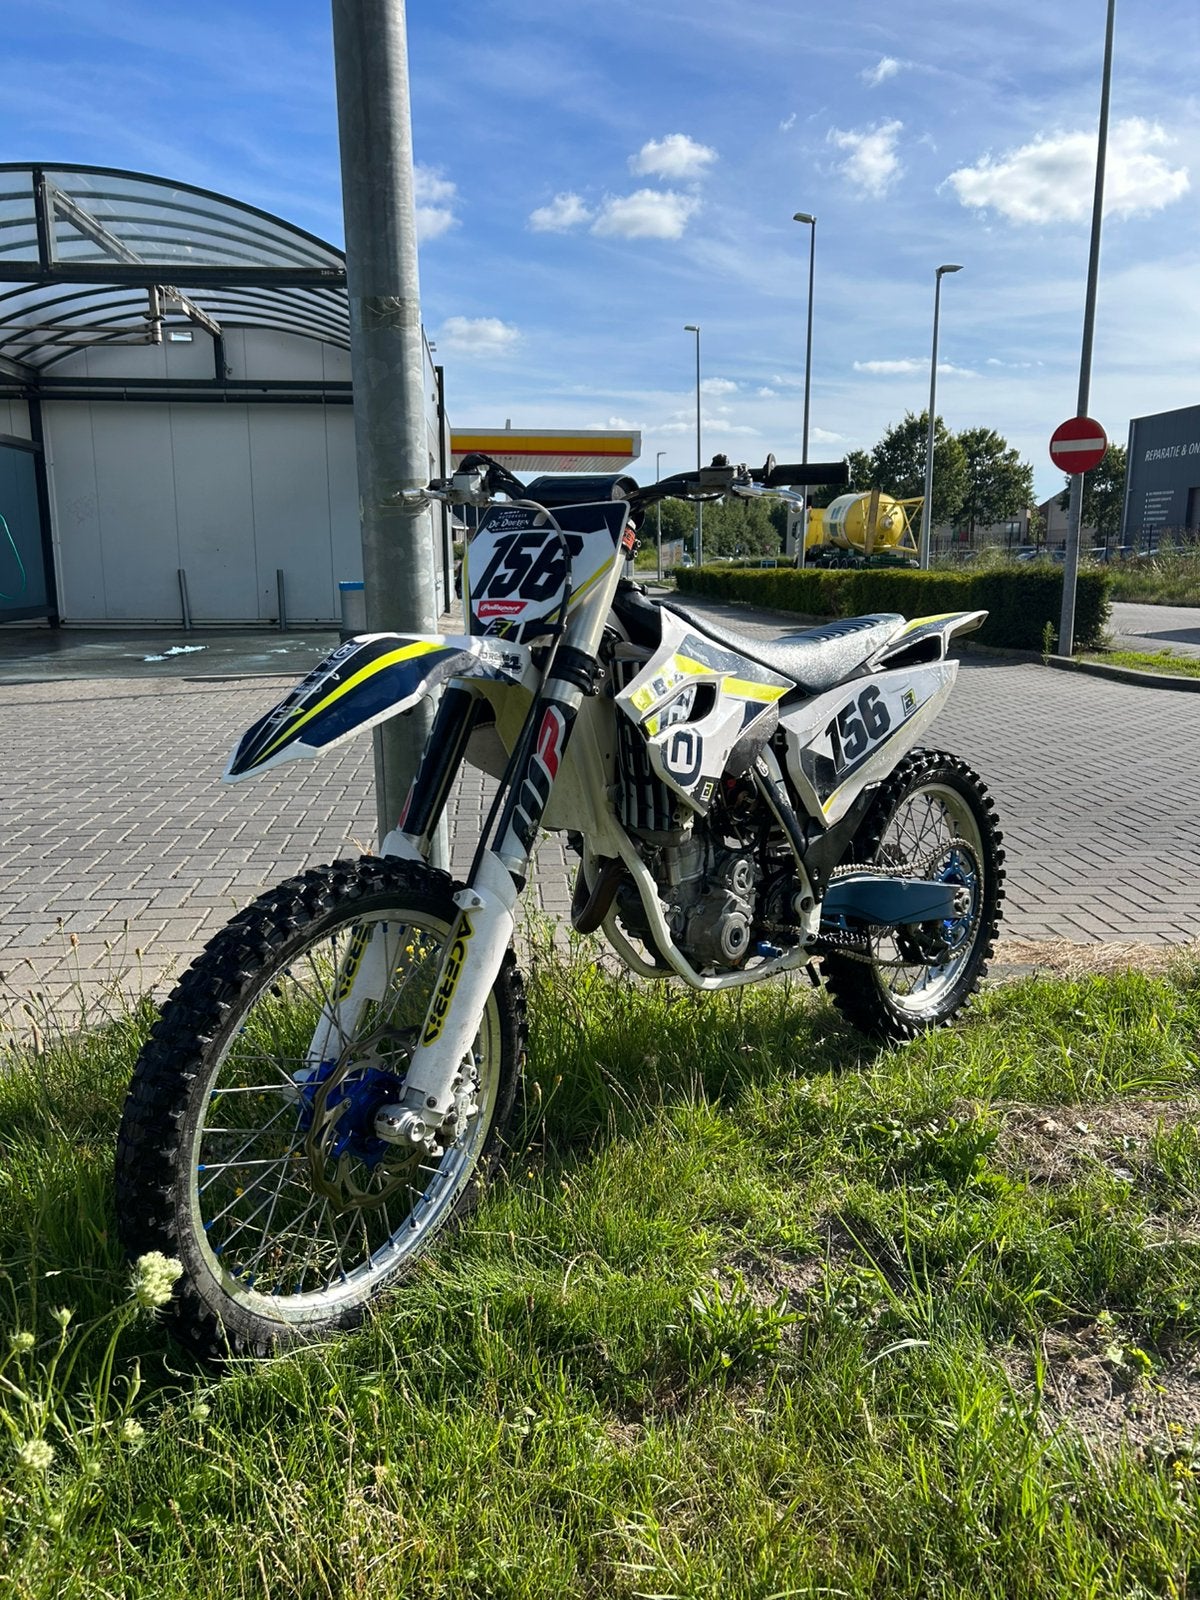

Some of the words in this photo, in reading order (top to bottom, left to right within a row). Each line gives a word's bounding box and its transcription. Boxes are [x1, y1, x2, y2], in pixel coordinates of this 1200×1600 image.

[1144, 445, 1180, 461] REPARATIE
[1181, 444, 1187, 456] &
[472, 533, 584, 602] 156
[825, 685, 890, 774] 156
